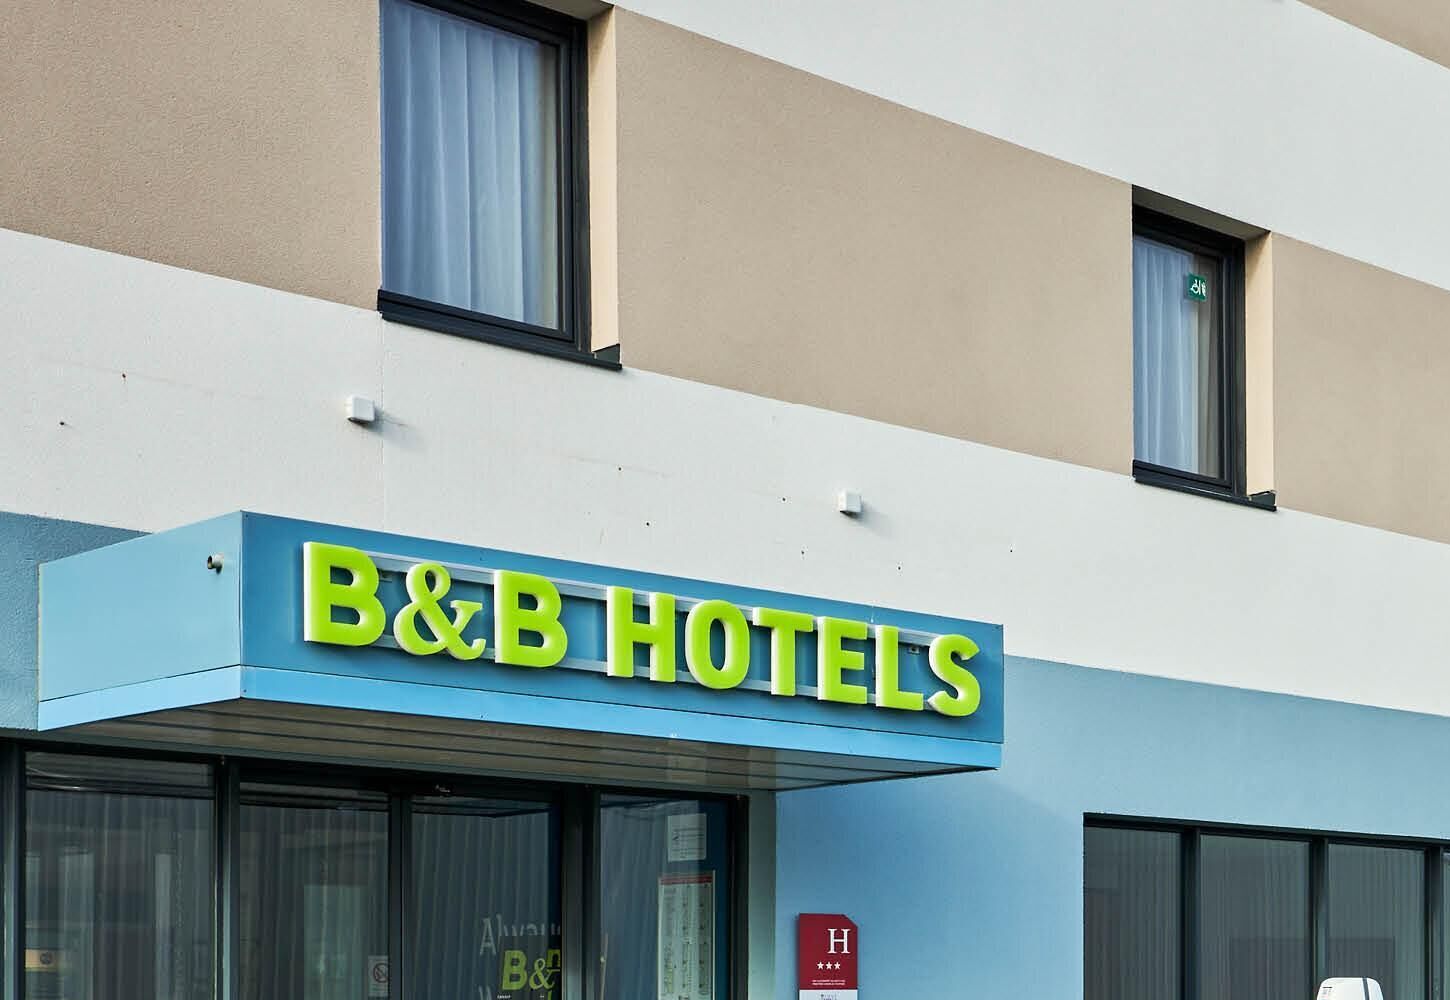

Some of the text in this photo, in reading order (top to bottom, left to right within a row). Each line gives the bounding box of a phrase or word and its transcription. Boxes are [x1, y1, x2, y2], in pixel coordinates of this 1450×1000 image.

[303, 541, 982, 718] B&B HOTELS
[827, 928, 851, 954] H
